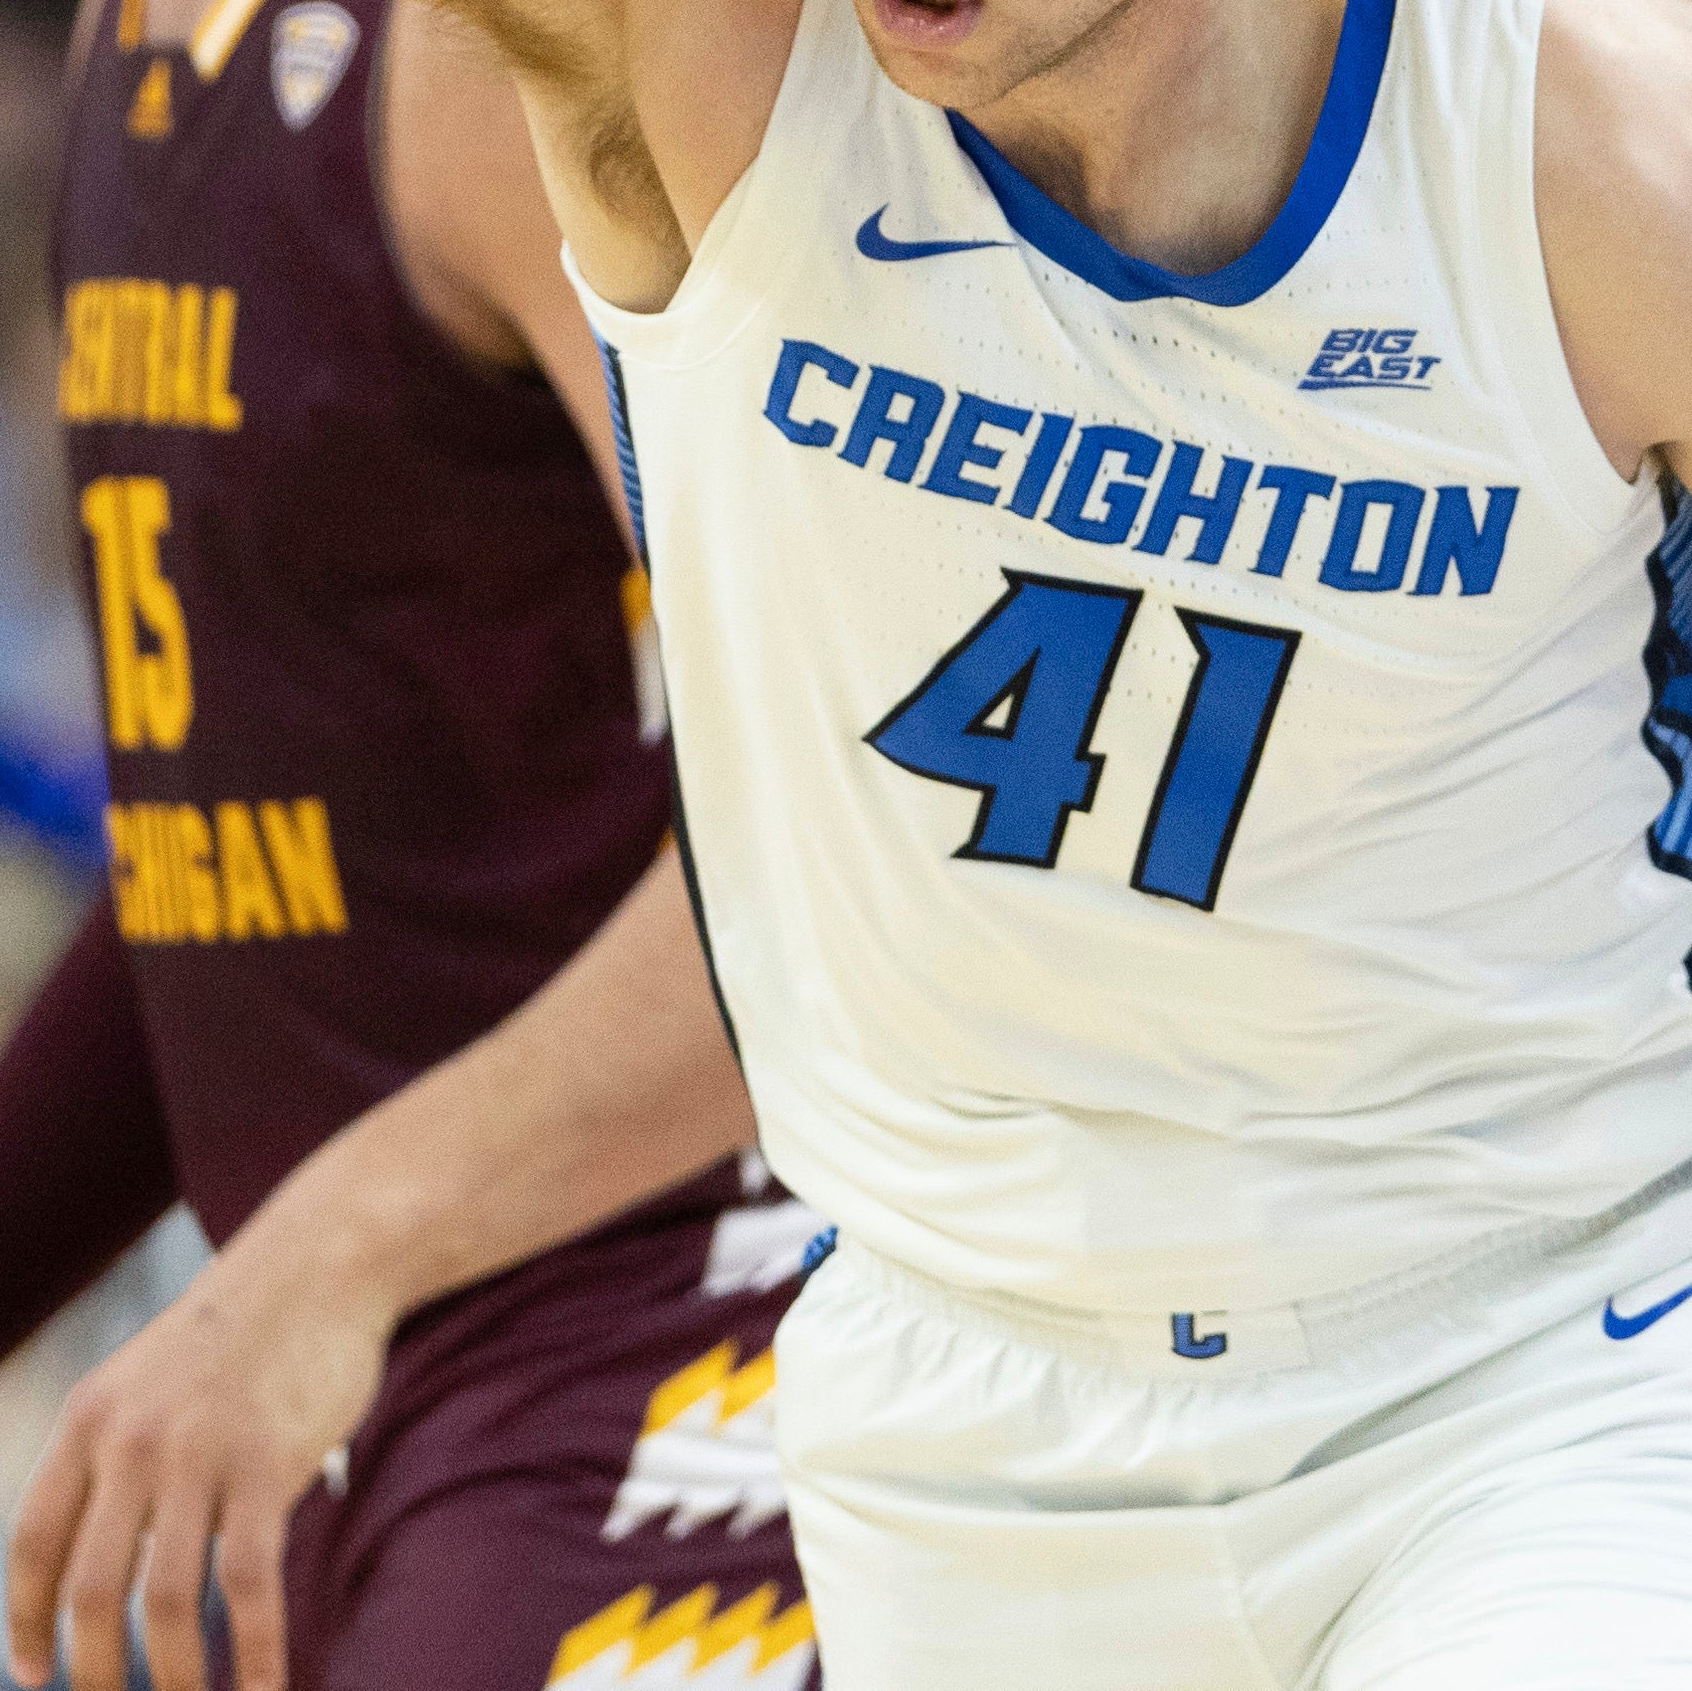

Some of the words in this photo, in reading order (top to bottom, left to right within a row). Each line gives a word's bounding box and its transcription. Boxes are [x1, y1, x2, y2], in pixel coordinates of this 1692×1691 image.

[763, 339, 1519, 596] CREIGHTON
[1307, 354, 1443, 379] EAST
[1321, 328, 1419, 354] BIG
[84, 478, 193, 750] 15
[864, 567, 1303, 911] 41
